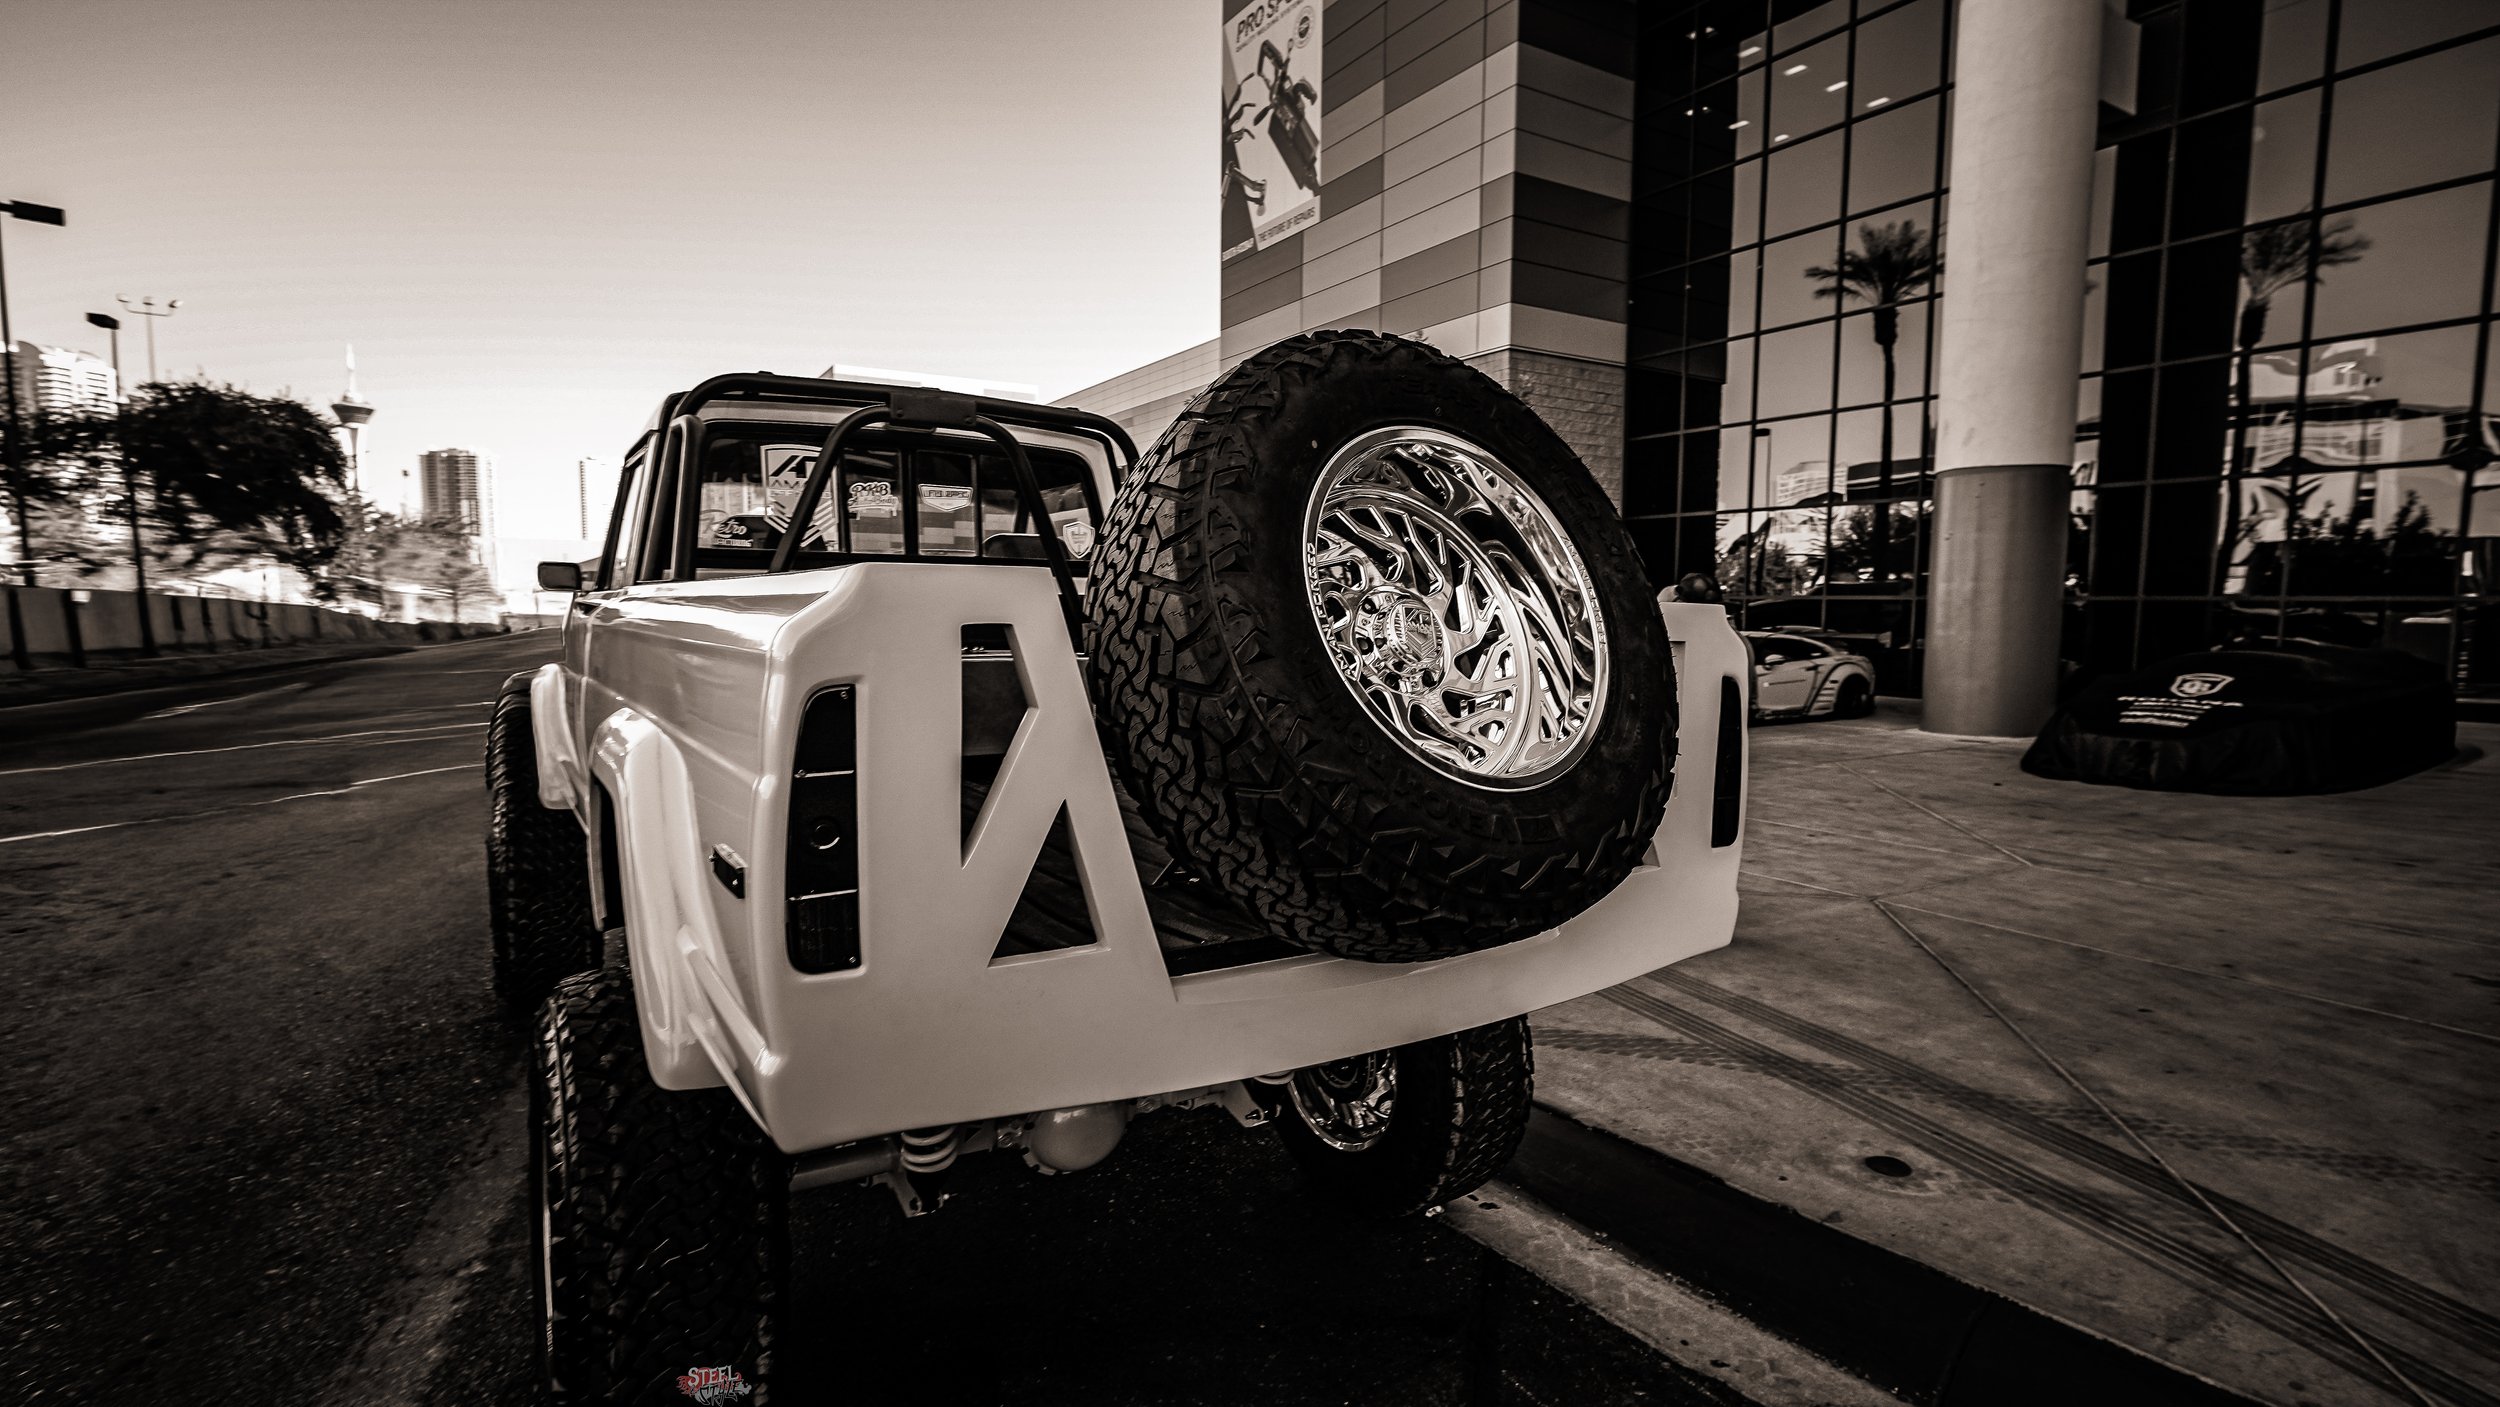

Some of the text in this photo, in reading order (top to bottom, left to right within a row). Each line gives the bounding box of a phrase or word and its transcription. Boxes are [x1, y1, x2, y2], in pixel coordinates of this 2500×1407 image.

[1237, 6, 1265, 43] PRO
[1306, 542, 1358, 682] AMANI FORGED
